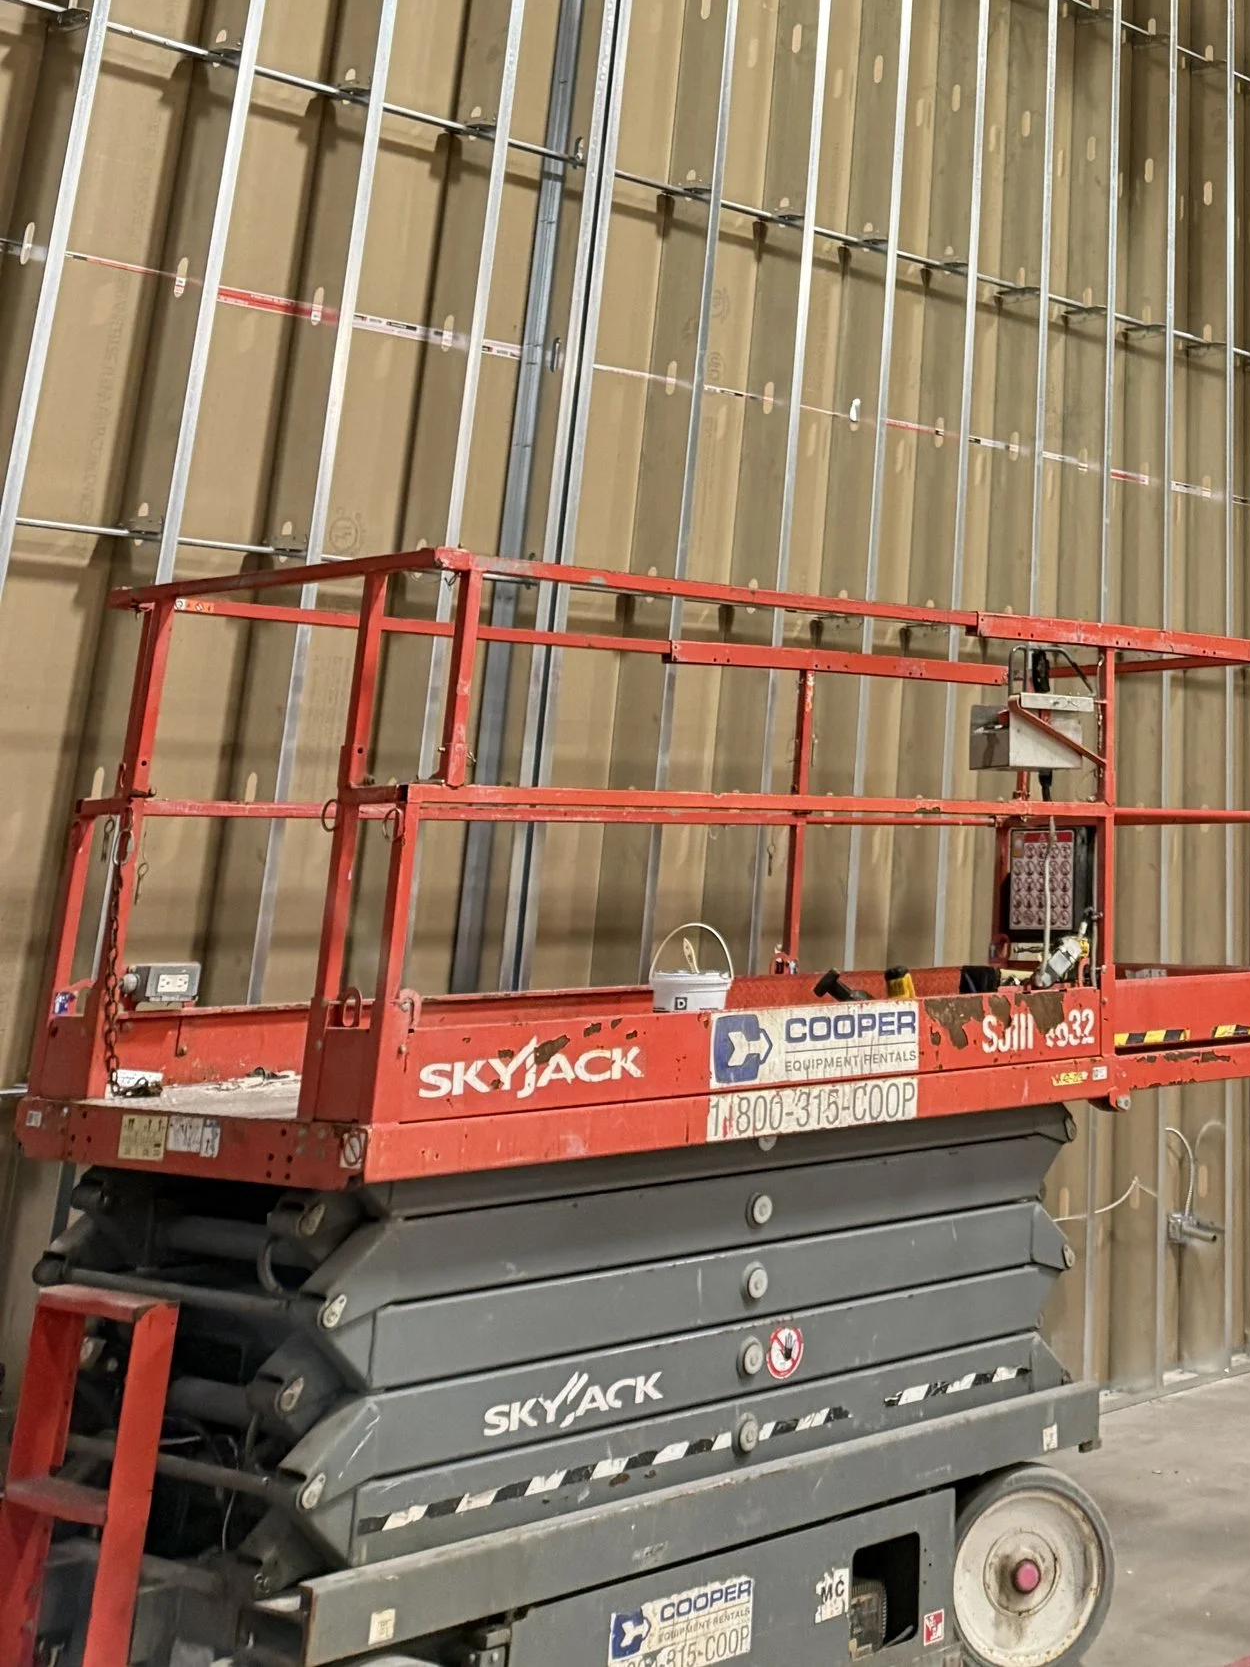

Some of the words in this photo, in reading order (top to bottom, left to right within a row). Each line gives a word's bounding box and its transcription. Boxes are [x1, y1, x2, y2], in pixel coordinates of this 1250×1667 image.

[785, 1010, 916, 1044] COOPER
[418, 1035, 645, 1099] SKYJACK
[785, 1055, 859, 1072] EQUIPMENT
[864, 1050, 917, 1064] RENTALS
[711, 1082, 916, 1137] 1800-315-COOP
[483, 1371, 665, 1436] SKYJACK
[660, 1580, 751, 1623] COOPER
[713, 1607, 750, 1625] RENTALS
